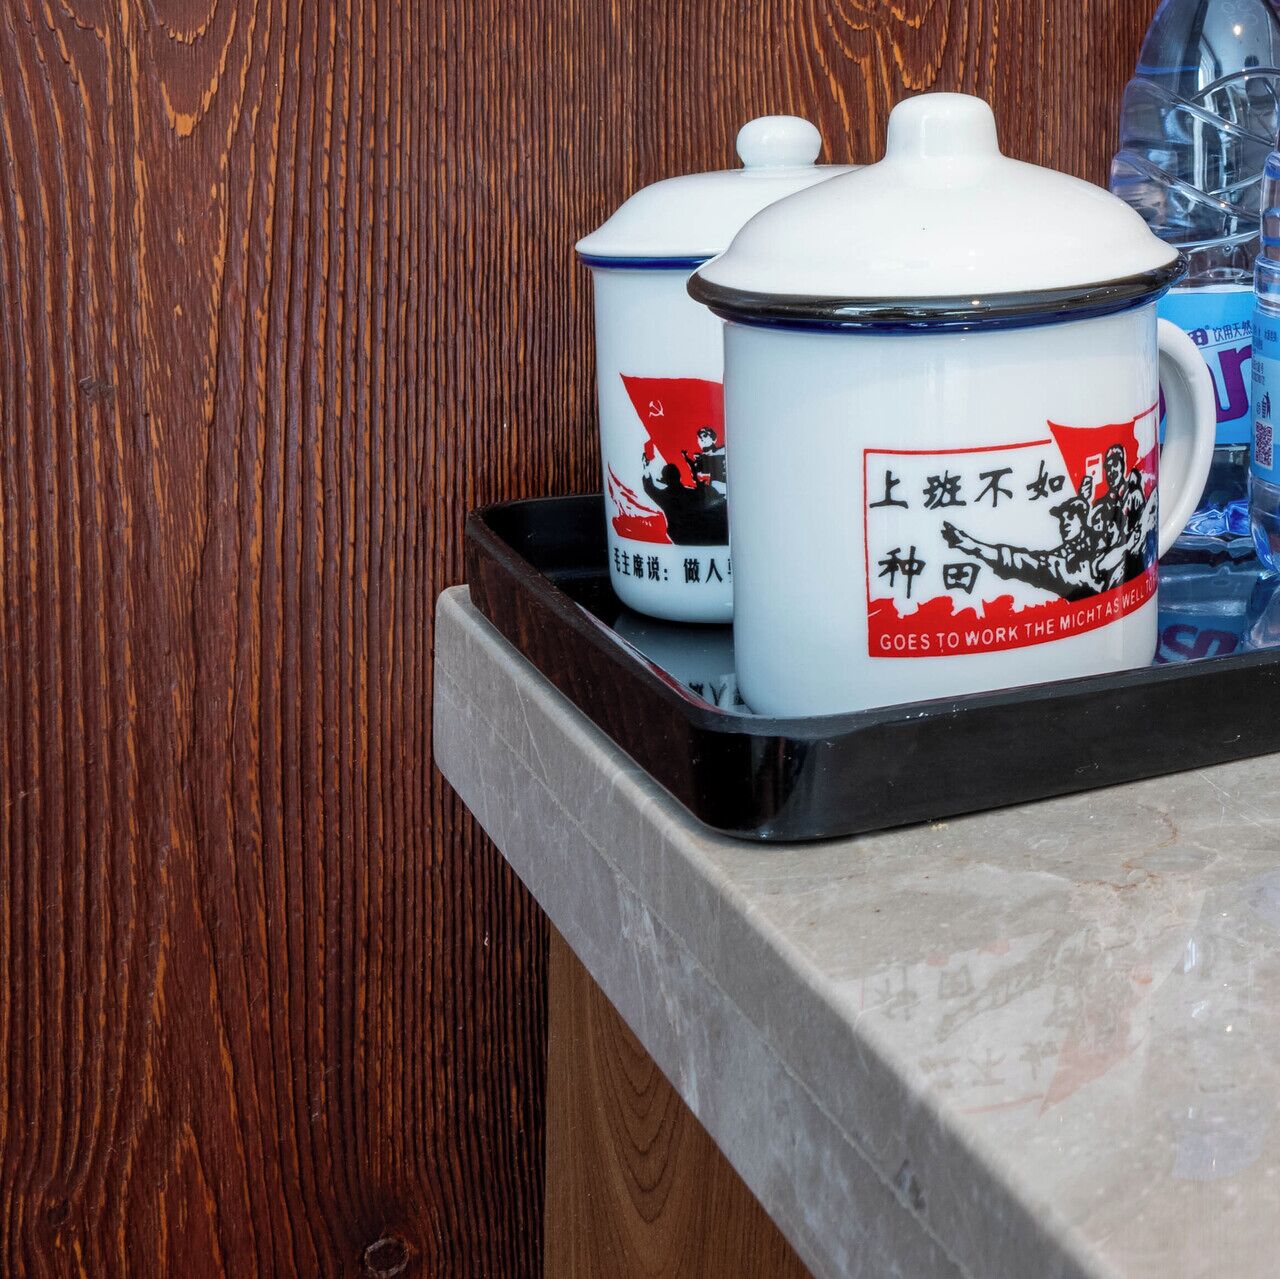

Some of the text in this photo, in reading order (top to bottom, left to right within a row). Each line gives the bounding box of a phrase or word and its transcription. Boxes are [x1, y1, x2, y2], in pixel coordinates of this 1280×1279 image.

[869, 459, 1065, 510] 上班不如
[878, 545, 981, 599] 种田
[880, 633, 931, 651] GOES
[936, 632, 960, 649] TO
[965, 625, 1018, 646] WORK
[1024, 617, 1055, 638] THE
[1105, 597, 1119, 617] AS
[1122, 586, 1144, 609] WELL
